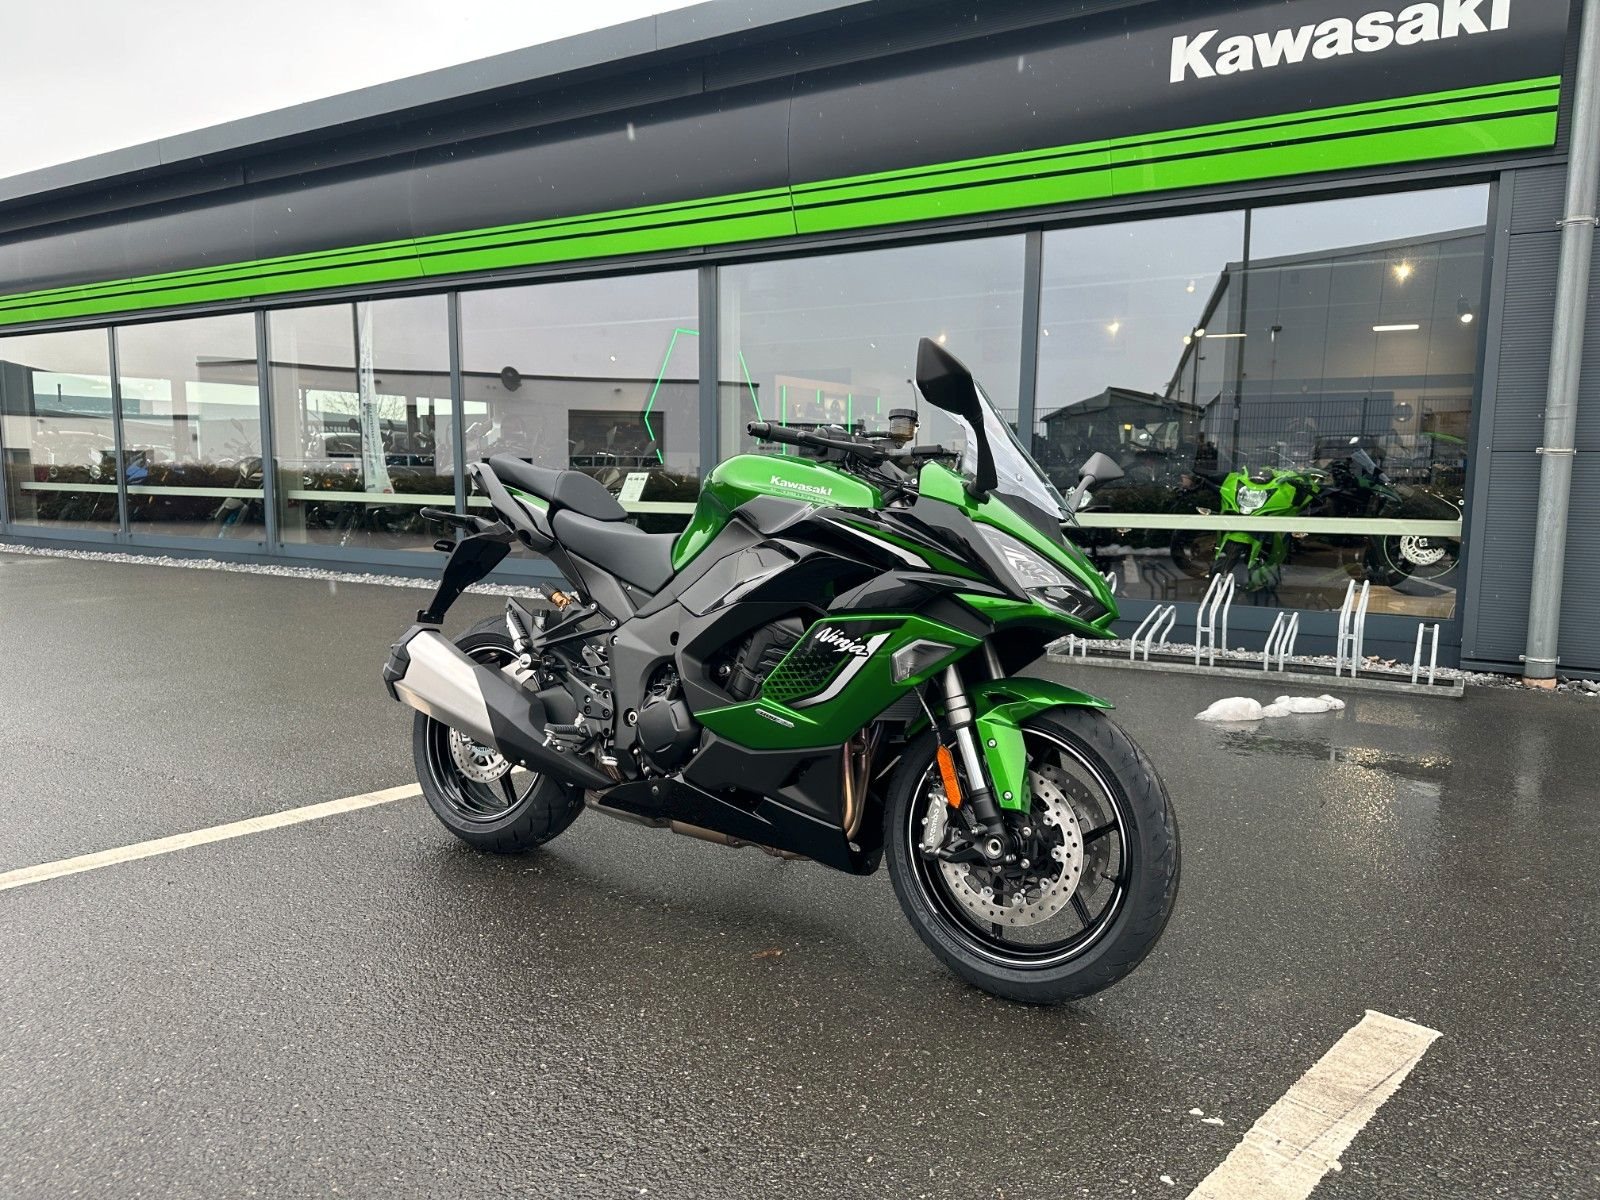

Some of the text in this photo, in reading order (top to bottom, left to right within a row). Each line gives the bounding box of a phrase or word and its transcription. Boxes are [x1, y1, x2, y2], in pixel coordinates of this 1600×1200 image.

[1169, 0, 1512, 83] Kawasaki
[770, 475, 832, 496] Kawasaki
[814, 627, 869, 656] Ninja
[927, 808, 939, 843] brembo
